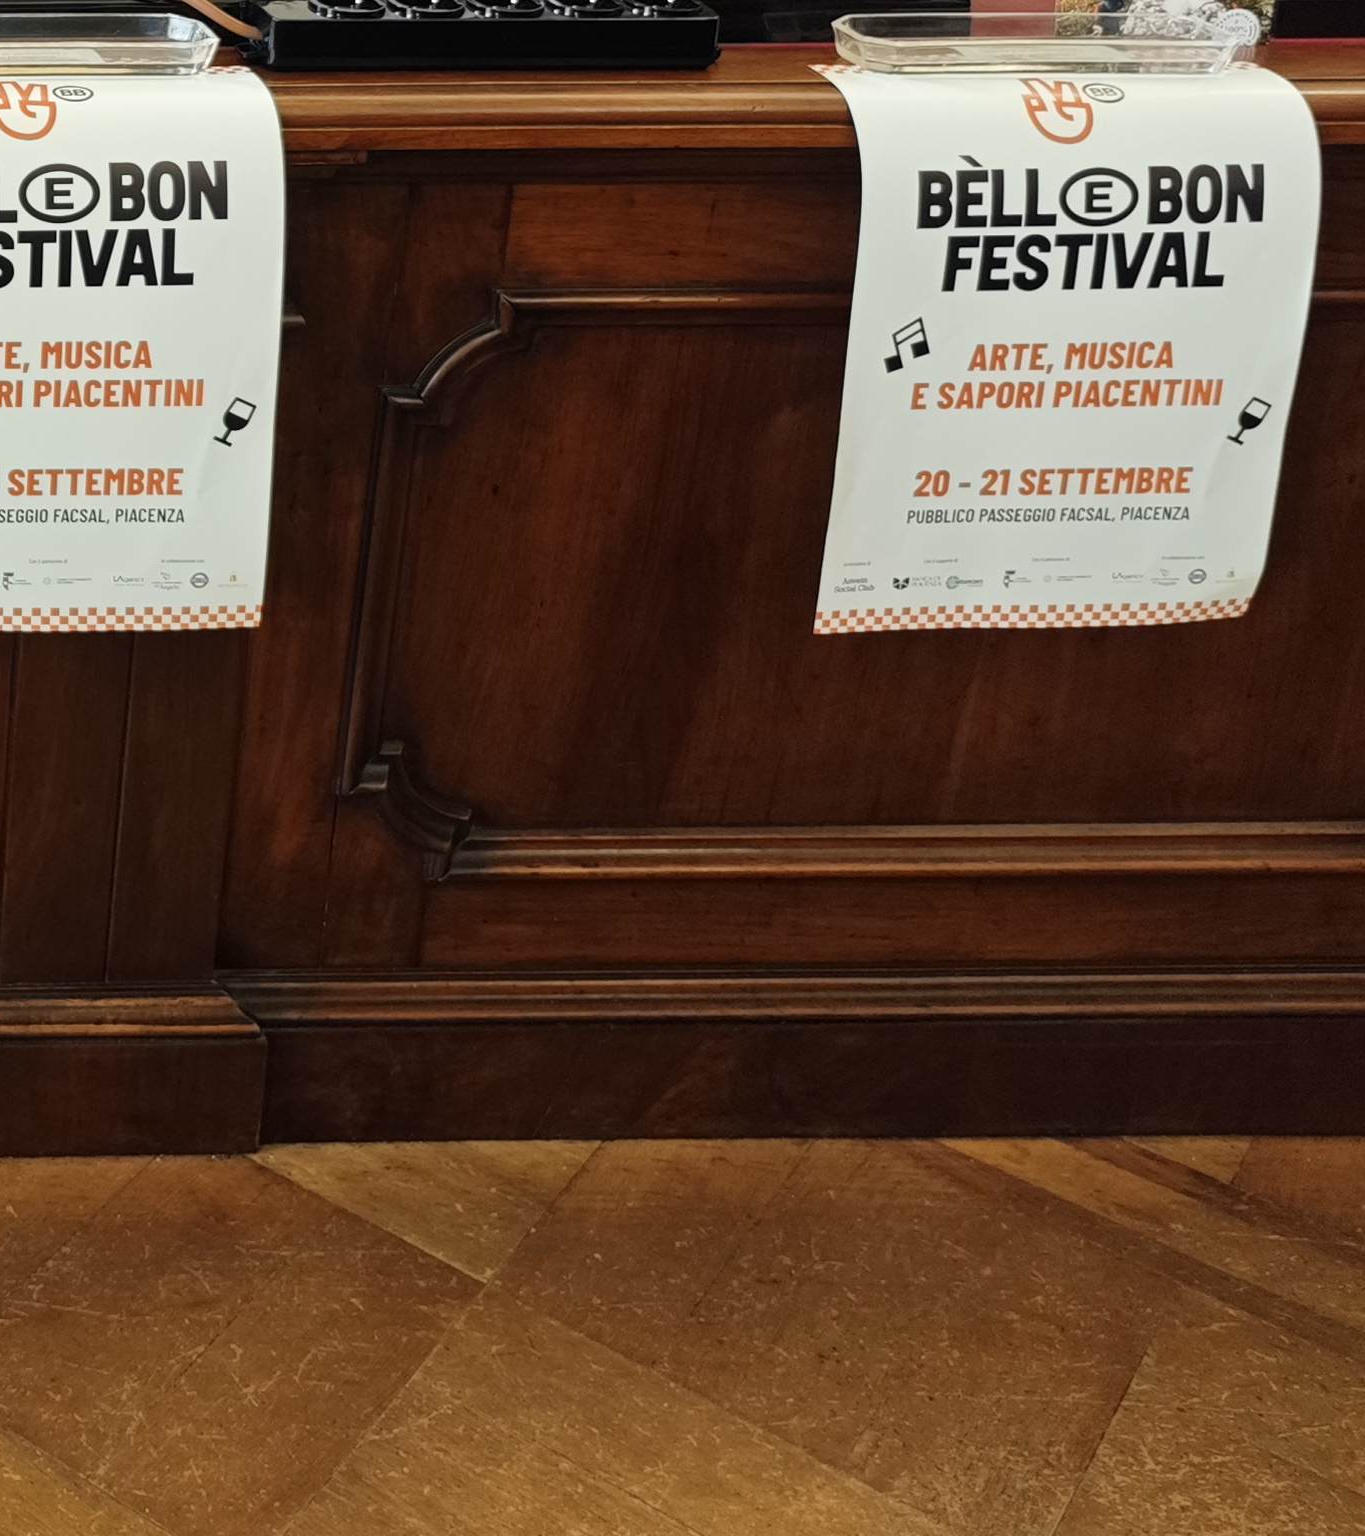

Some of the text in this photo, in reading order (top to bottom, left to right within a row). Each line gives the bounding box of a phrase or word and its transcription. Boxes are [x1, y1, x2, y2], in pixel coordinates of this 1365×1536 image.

[109, 161, 228, 222] BON
[917, 155, 1057, 229] BÈLL
[1147, 164, 1264, 225] BON
[941, 231, 1225, 292] FESTIVAL
[41, 341, 152, 369] MUSICA
[968, 341, 1173, 374] ARTE, MUSICA
[33, 379, 204, 407] PIACENTINI
[911, 379, 1223, 410] E SAPORI PIACENTINI
[8, 468, 183, 496] SETTEMBRE
[914, 470, 950, 497] 20
[980, 469, 1010, 496] 21
[1019, 467, 1193, 496] SETTEMBRE
[53, 509, 109, 524] FACSAL,
[115, 508, 184, 523] PIACENZA
[907, 507, 1189, 524] PUBBLICO PASSEGGIO FACSAL, PIACENZA
